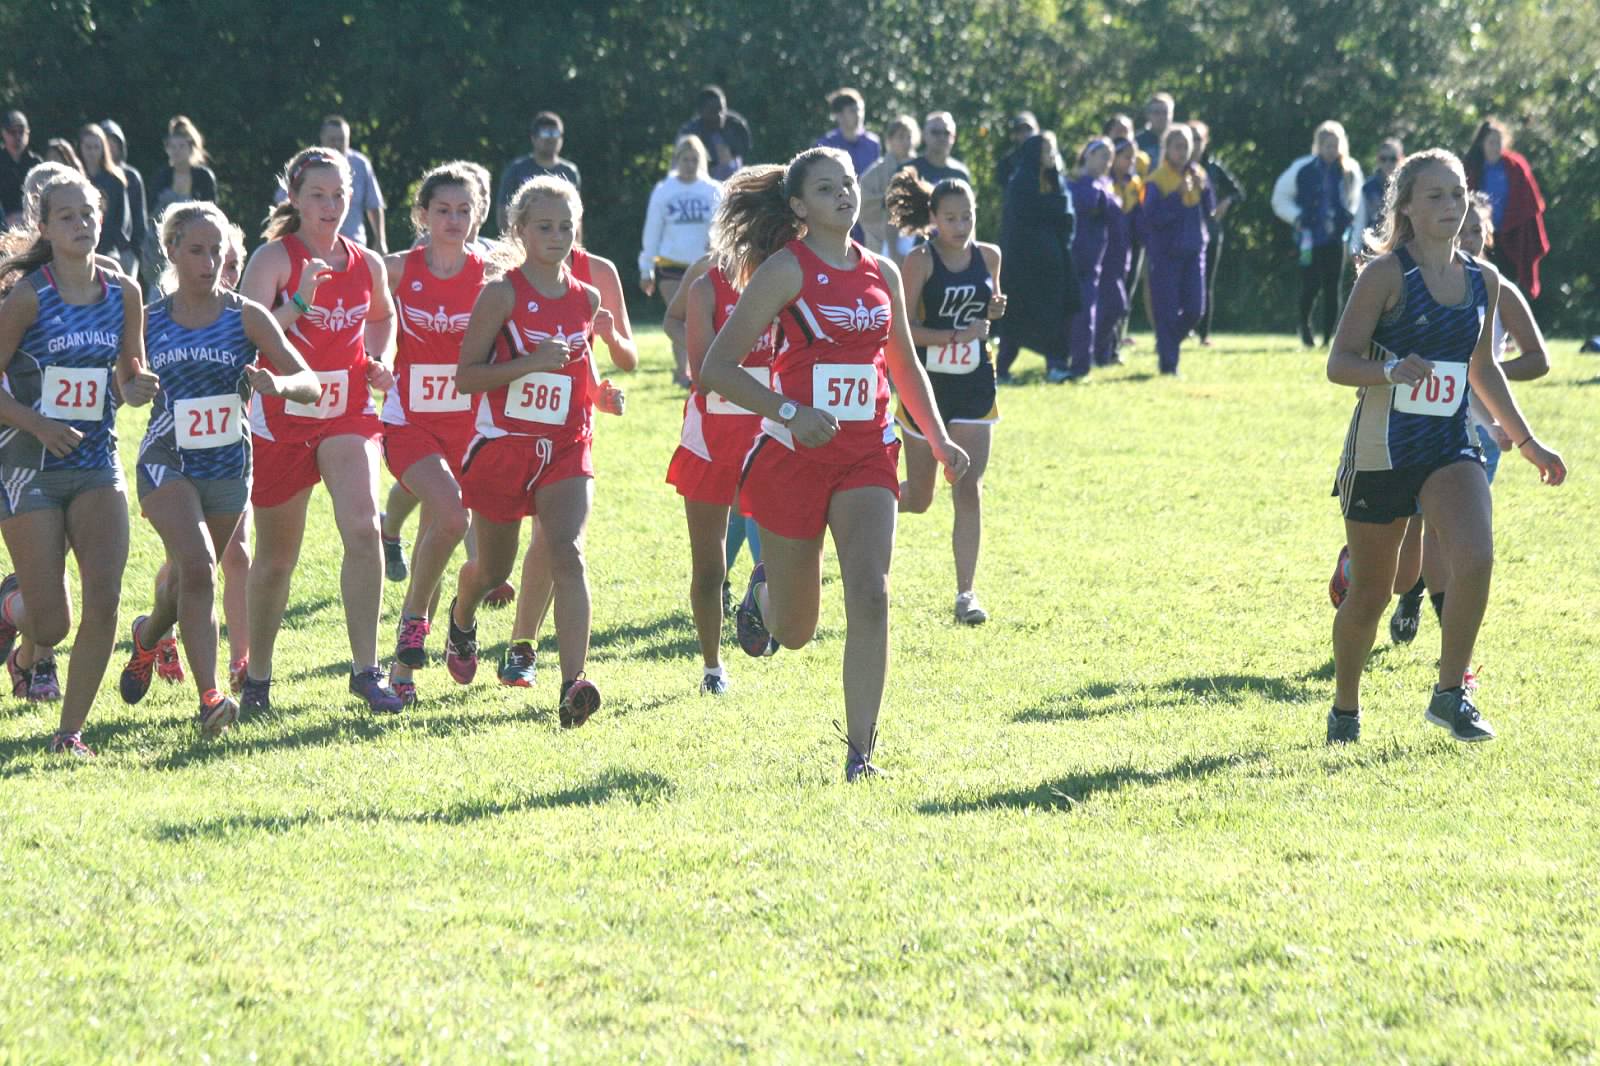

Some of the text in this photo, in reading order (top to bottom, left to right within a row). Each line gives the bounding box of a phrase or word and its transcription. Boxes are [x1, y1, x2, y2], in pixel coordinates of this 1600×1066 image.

[48, 330, 119, 353] GRAIN VALLE
[938, 341, 971, 365] 712
[152, 346, 237, 370] GRAIN VALLEY
[55, 379, 98, 408] 213
[314, 382, 341, 407] 75
[520, 382, 561, 411] 586
[828, 377, 869, 407] 578
[188, 407, 232, 437] 217
